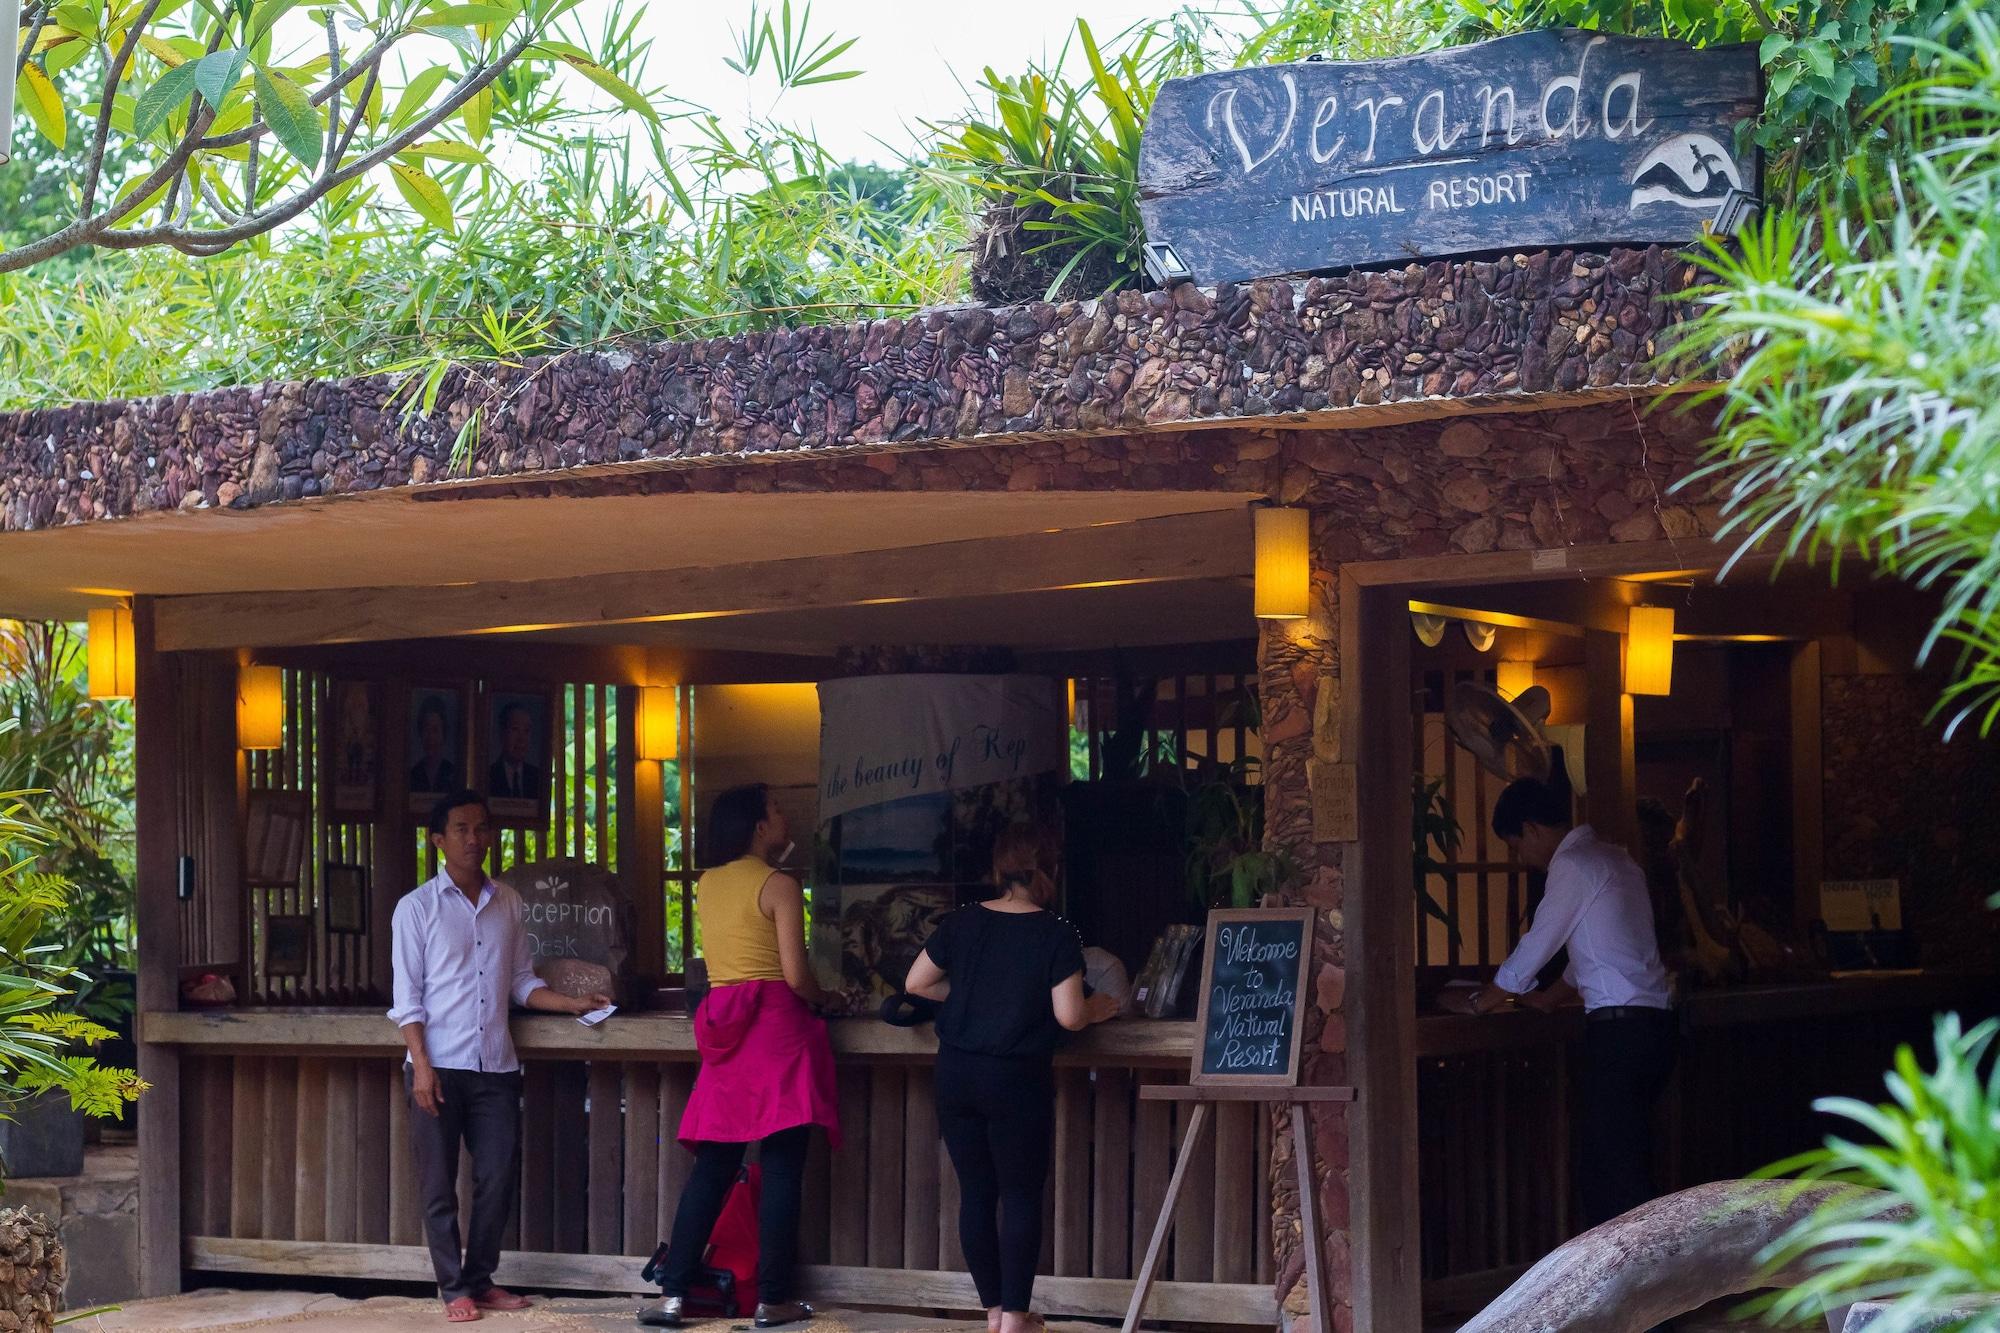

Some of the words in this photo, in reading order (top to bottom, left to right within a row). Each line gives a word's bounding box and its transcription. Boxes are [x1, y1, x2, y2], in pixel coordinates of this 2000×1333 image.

[1206, 35, 1654, 174] Veranda
[1290, 185, 1405, 223] NATURAL
[1429, 172, 1533, 209] RESORT
[826, 764, 848, 799] the
[854, 756, 923, 789] beauty
[935, 736, 961, 785] of
[973, 724, 1026, 770] Kep
[1219, 925, 1298, 965] Welcome
[1212, 978, 1294, 1015] Veranda
[1243, 965, 1264, 989] to
